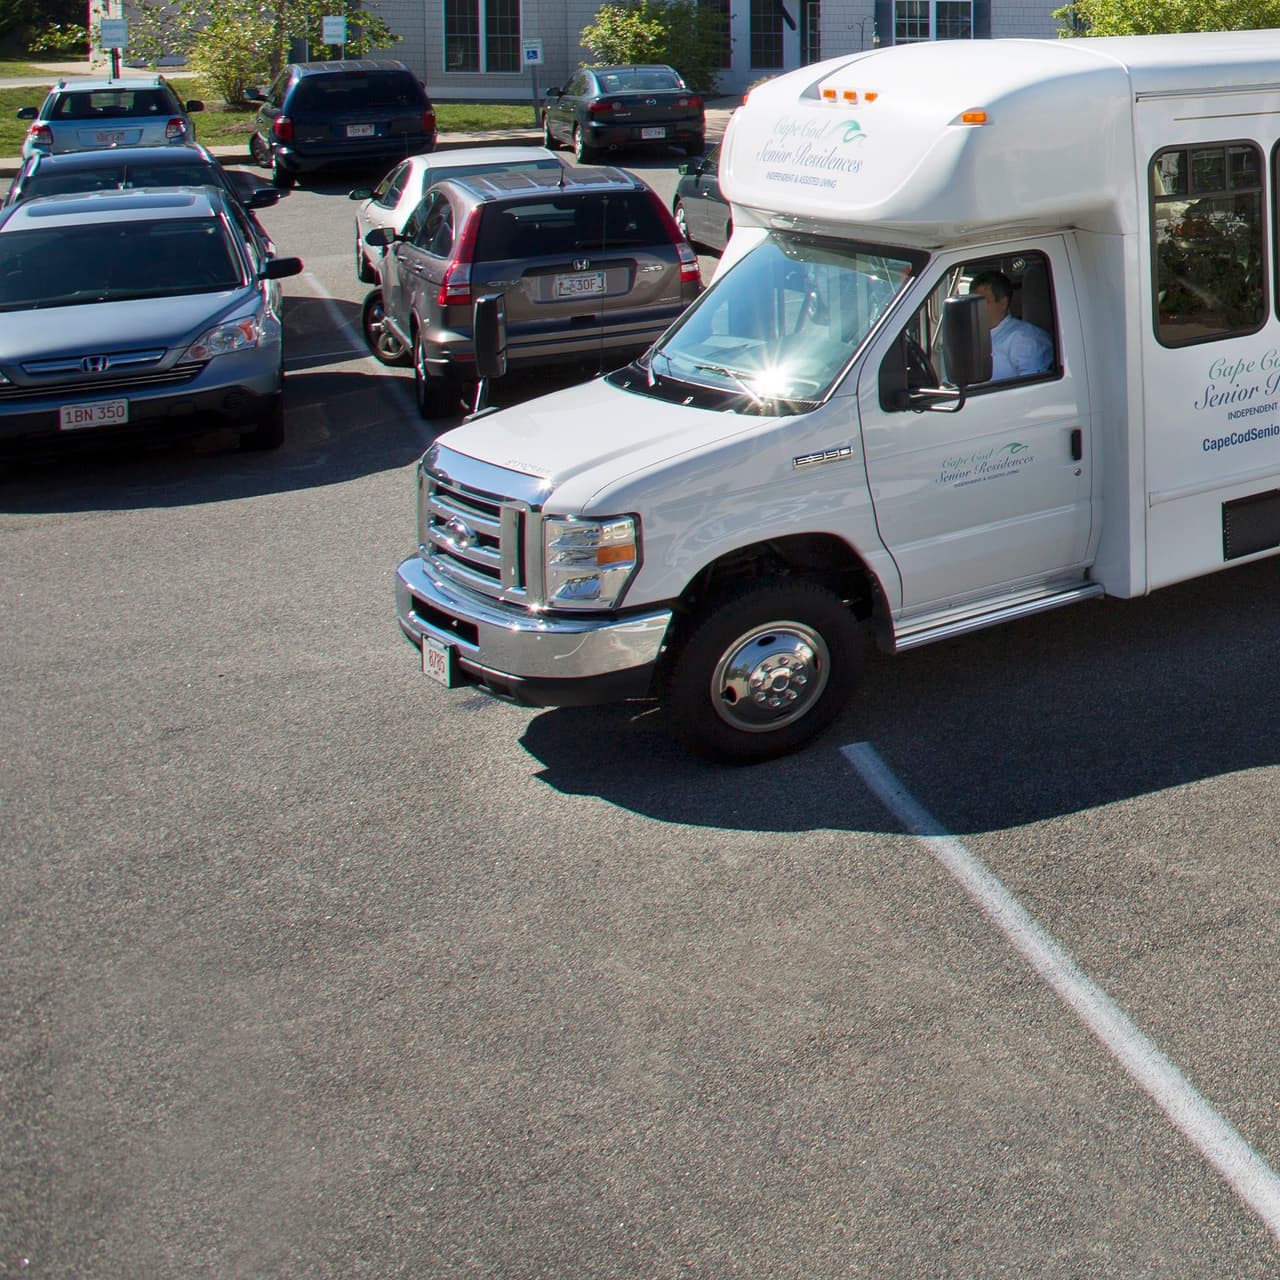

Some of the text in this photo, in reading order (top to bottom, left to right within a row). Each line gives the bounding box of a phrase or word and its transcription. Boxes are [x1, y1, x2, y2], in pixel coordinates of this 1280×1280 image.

[774, 116, 831, 142] Cape Cod
[757, 140, 863, 173] Senior Residences
[1208, 358, 1255, 384] Cape
[1194, 384, 1259, 410] Senior
[65, 405, 125, 423] 1BN 350
[1228, 402, 1278, 420] INDEPENDENT
[936, 470, 972, 483] Senior
[974, 456, 1035, 474] Residences
